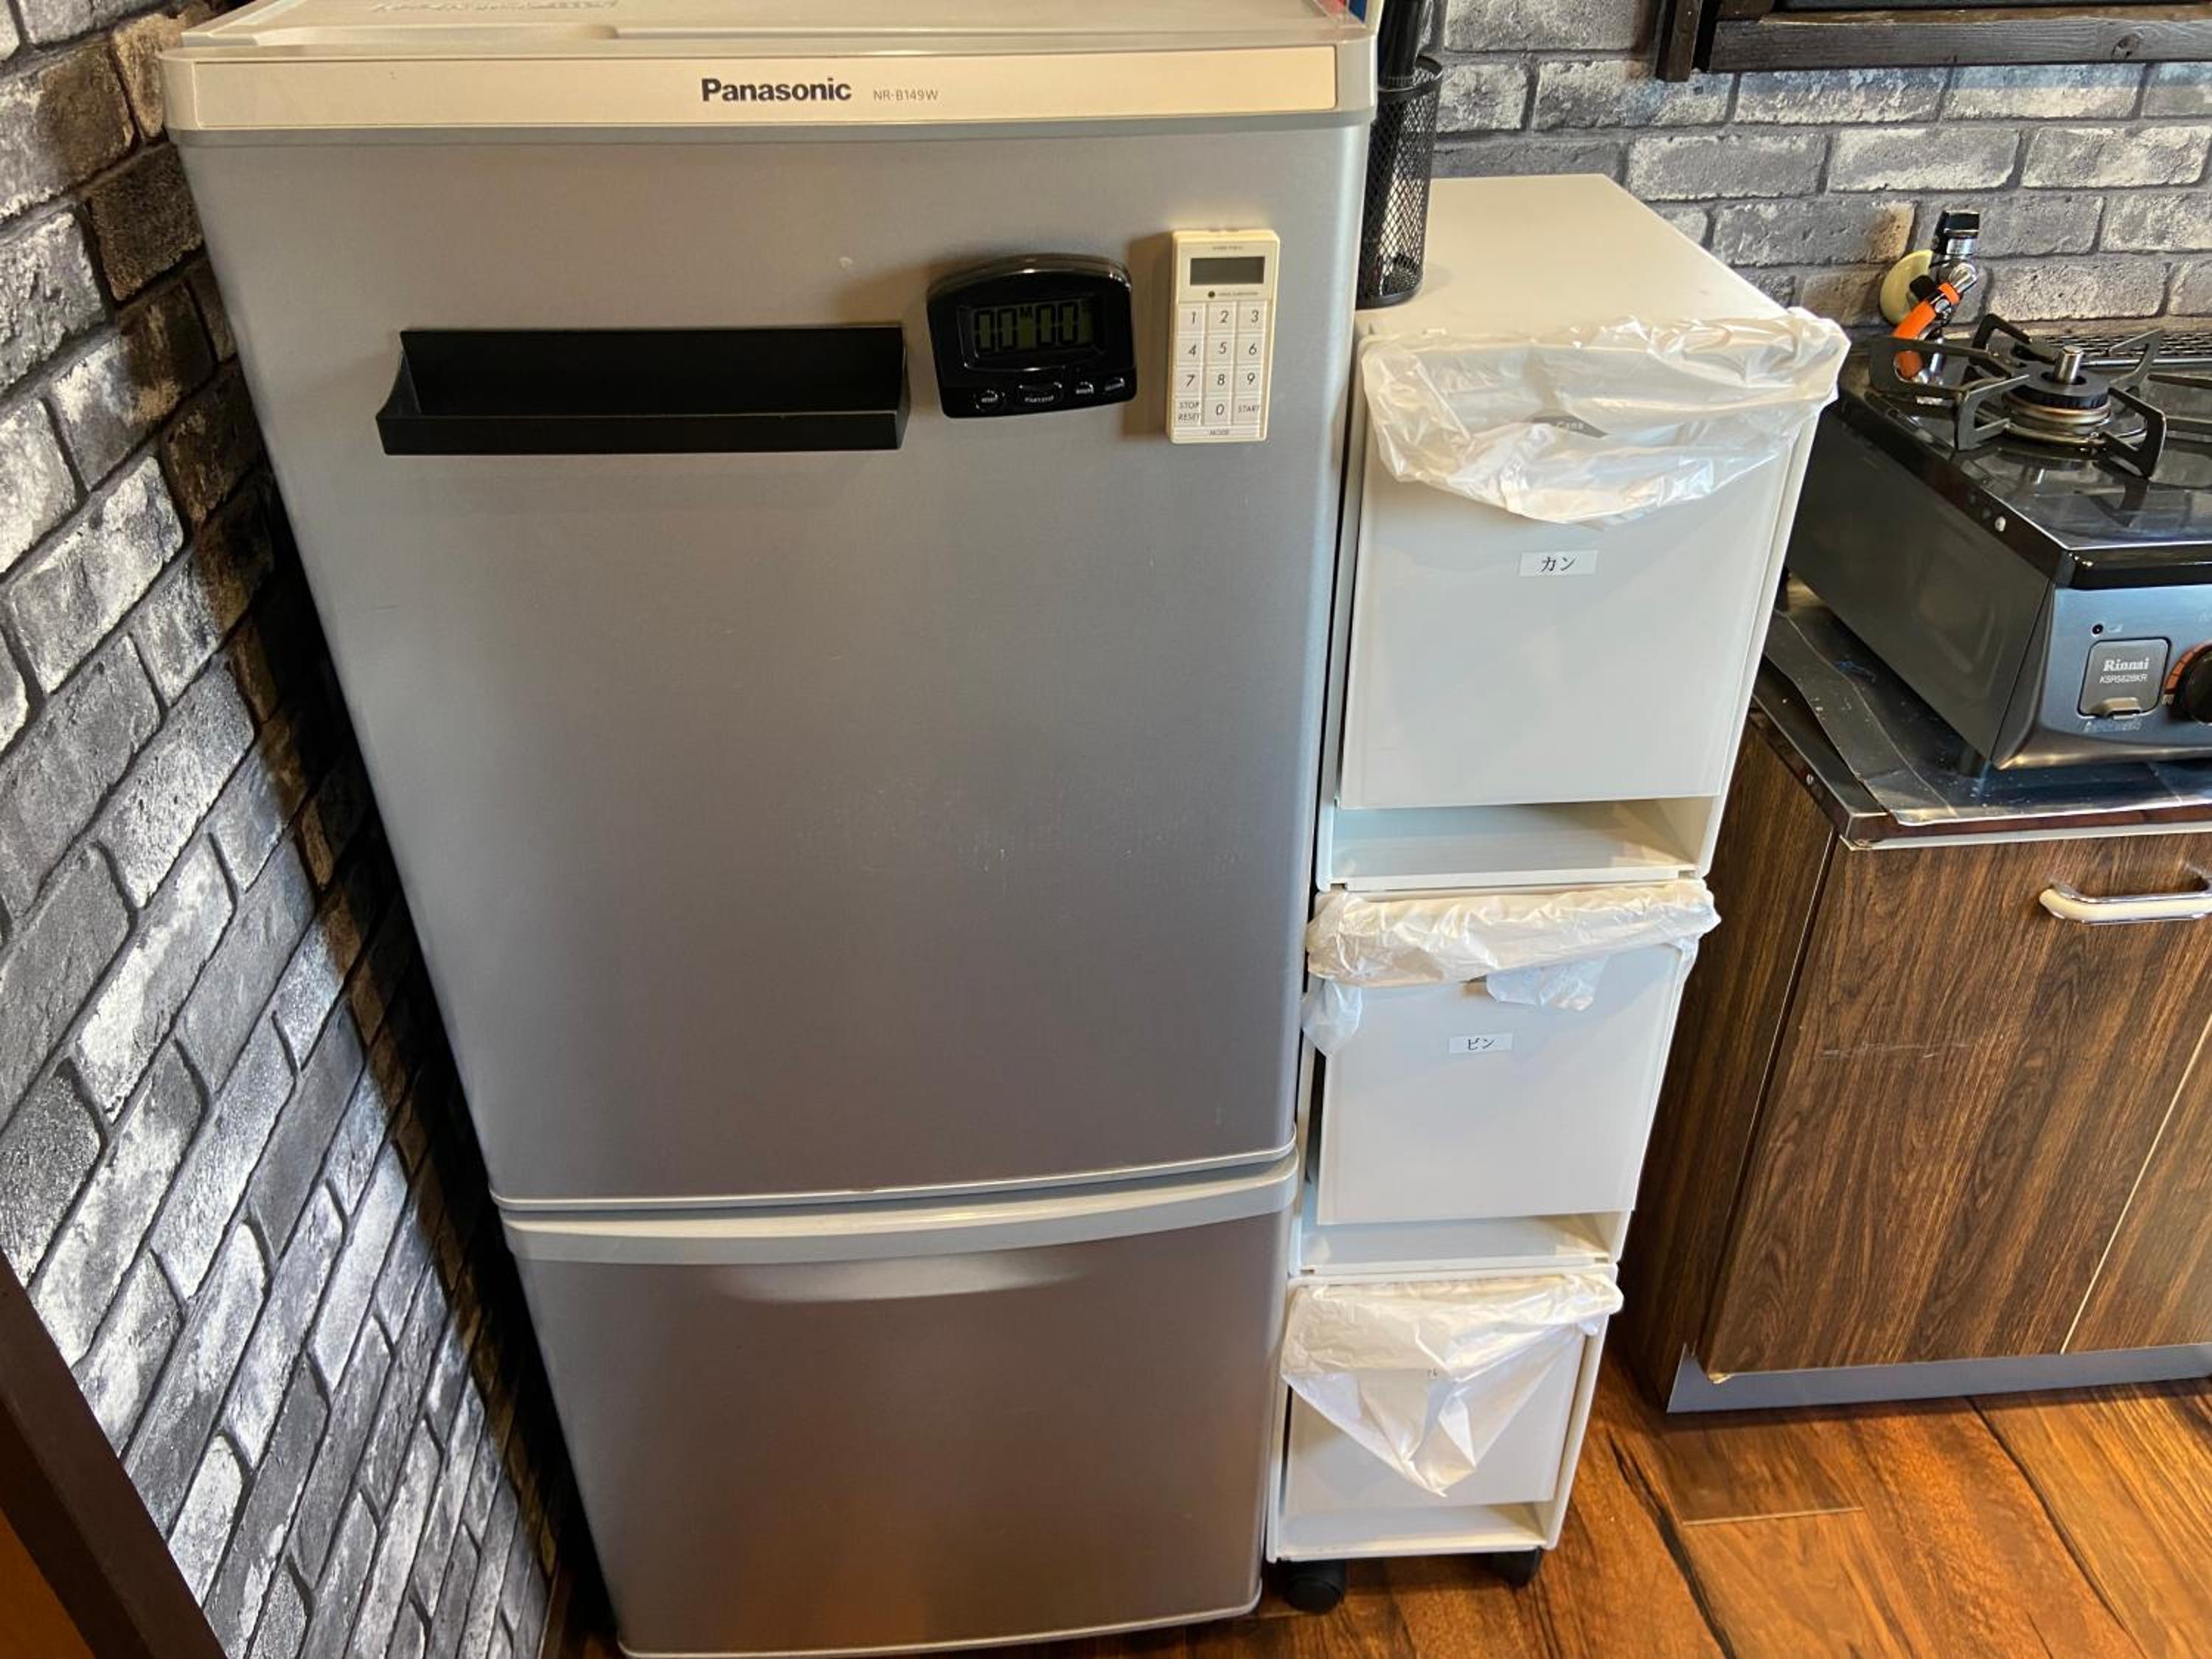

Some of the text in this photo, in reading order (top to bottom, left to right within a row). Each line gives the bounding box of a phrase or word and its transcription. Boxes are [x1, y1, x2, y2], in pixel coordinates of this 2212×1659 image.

[701, 77, 939, 102] Panasonic NR-B149W
[1191, 310, 1259, 324] 1 2 3
[1188, 341, 1257, 357] 4 5 6
[1186, 372, 1256, 387] 7 8 9
[1215, 403, 1225, 416] 0
[1238, 405, 1260, 414] START
[1540, 556, 1576, 572] カン
[2103, 657, 2149, 672] Rinnai
[1467, 1037, 1495, 1051] ビン
